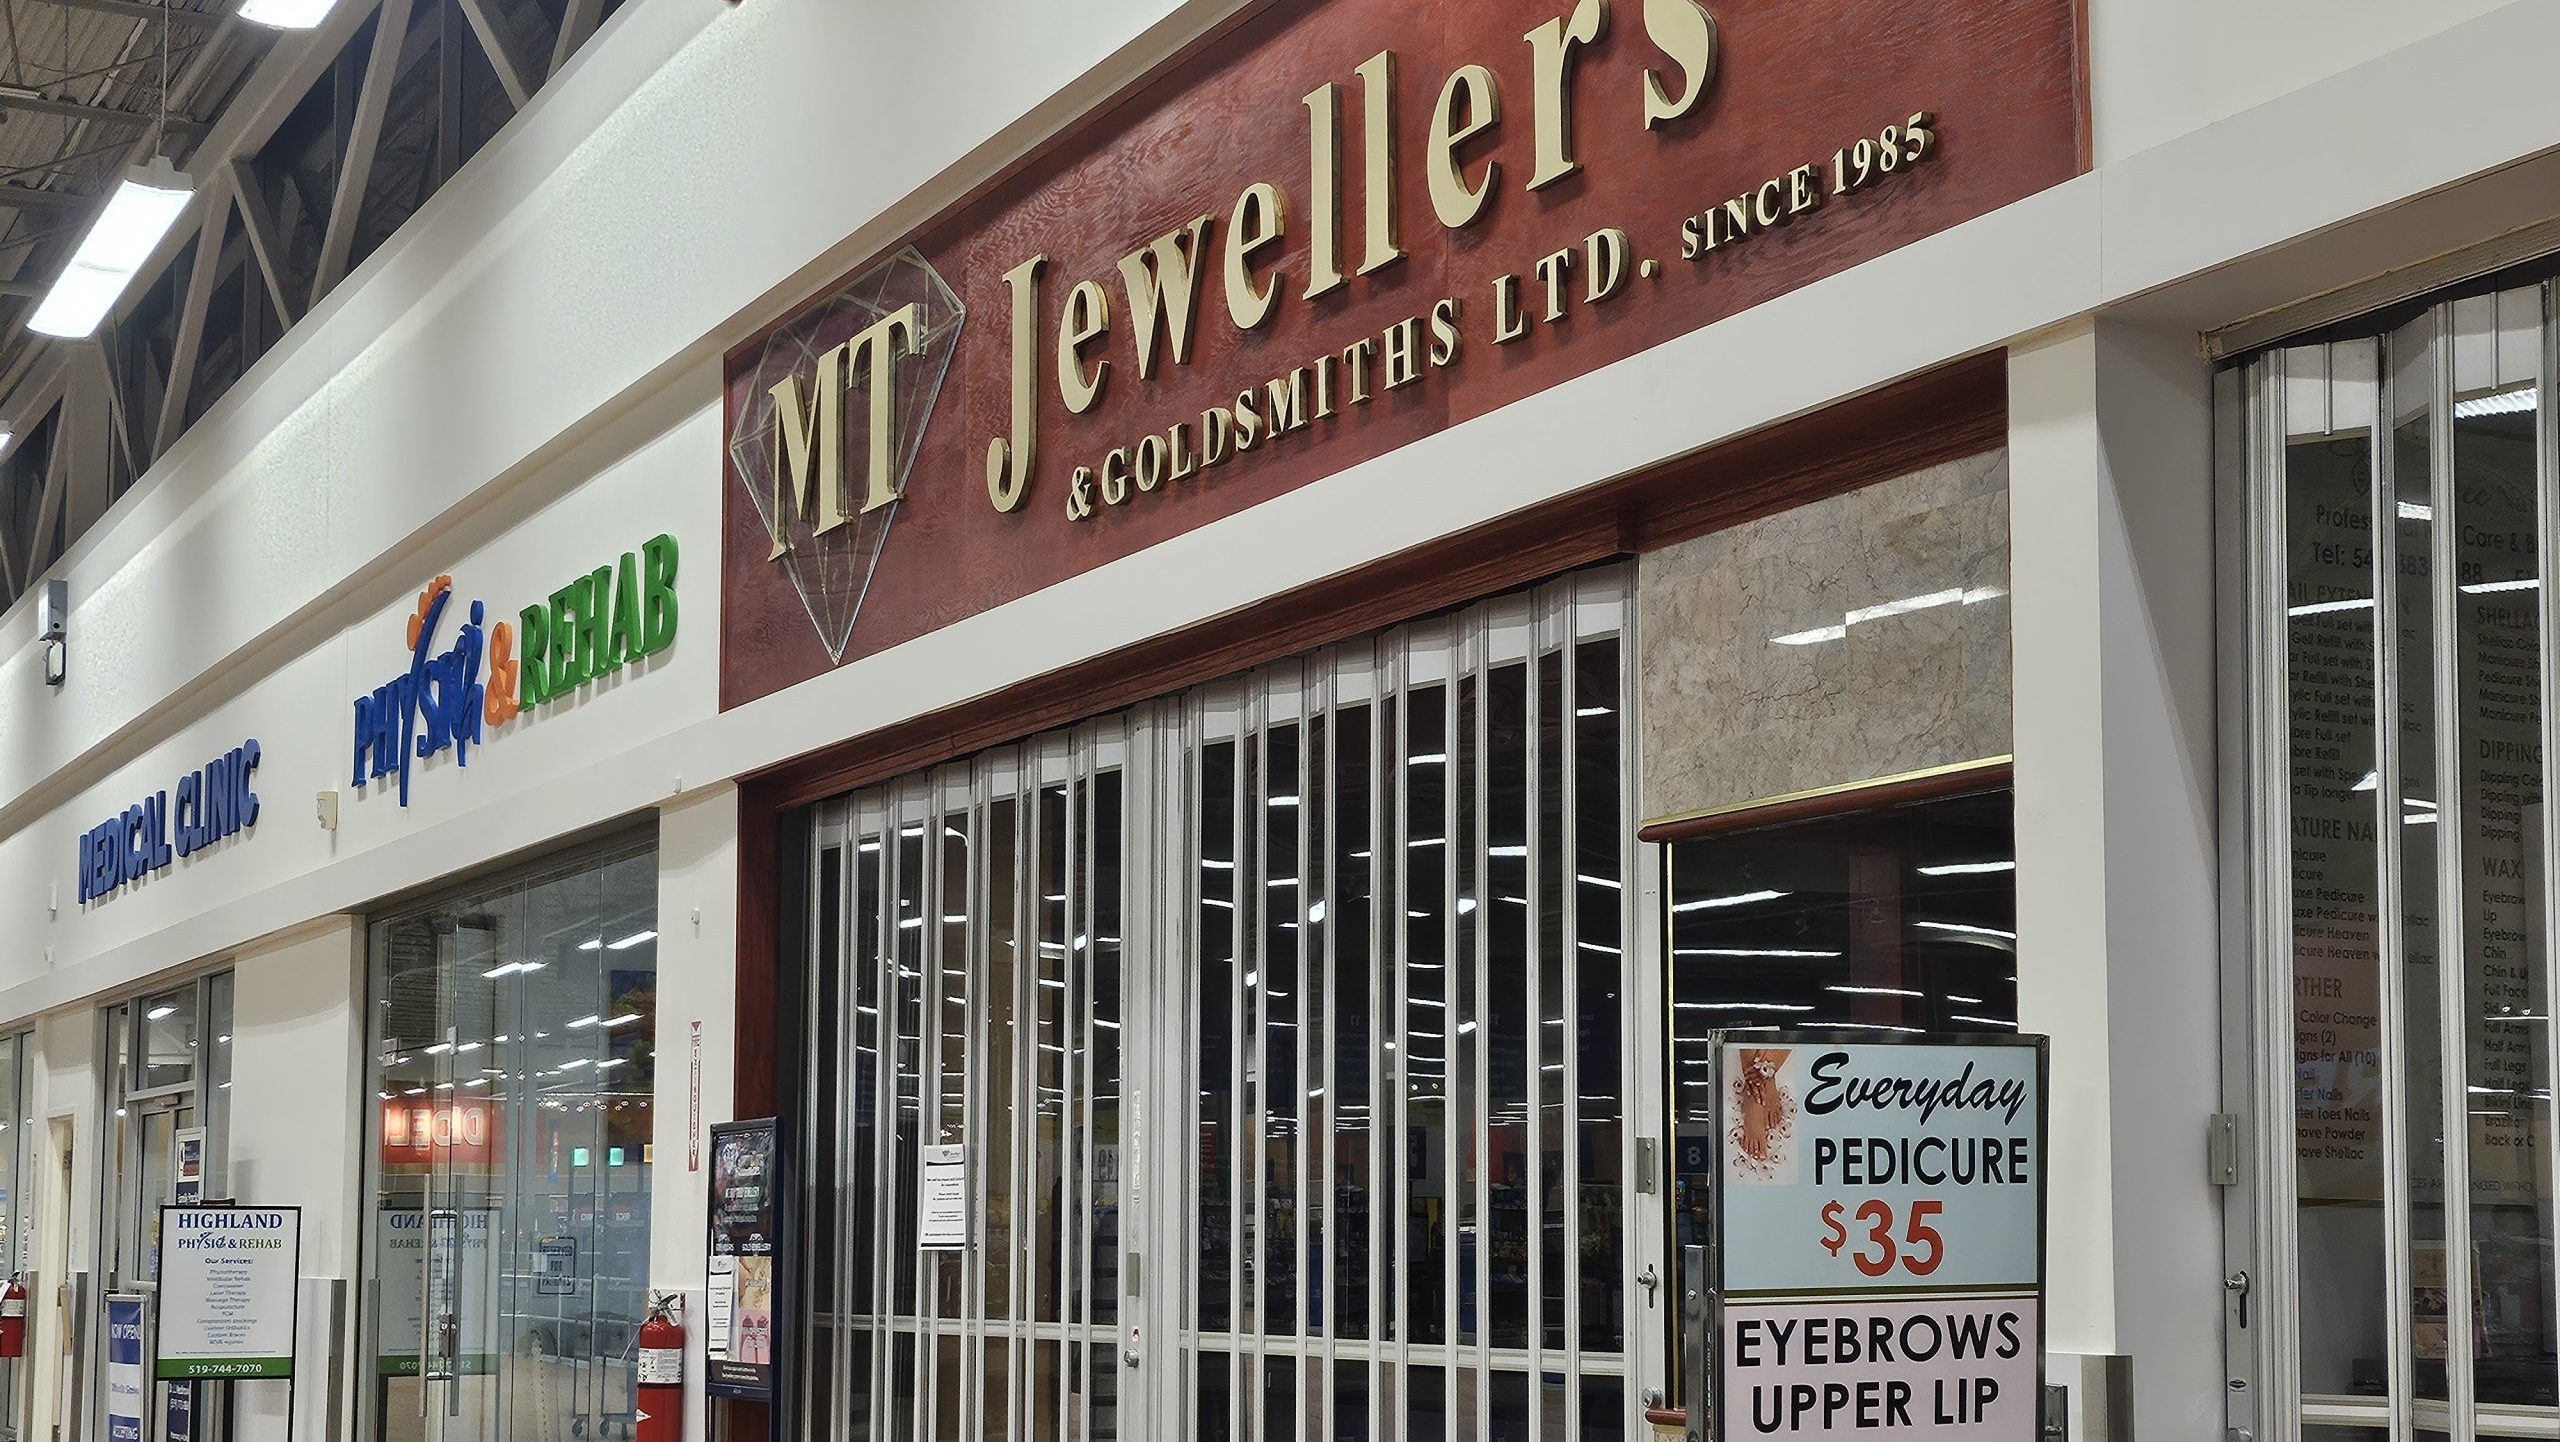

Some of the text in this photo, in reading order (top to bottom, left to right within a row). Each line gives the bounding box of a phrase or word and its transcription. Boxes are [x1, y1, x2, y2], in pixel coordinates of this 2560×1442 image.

[1492, 226, 1660, 345] LTD.
[1680, 162, 1820, 261] SINCE
[1831, 111, 1938, 196] 1985
[986, 0, 1719, 514] Jewellers
[767, 303, 928, 562] MT
[519, 534, 679, 713] REHAB
[2336, 731, 2351, 743] set
[2480, 769, 2519, 788] Dipping
[78, 738, 261, 904] MEDICAL CLINIC
[2481, 807, 2520, 825] Dipping
[2481, 825, 2520, 844] Dipping
[2316, 887, 2365, 904] Pedicure
[2316, 906, 2364, 923] Pedicure
[2484, 946, 2507, 960] Chin
[2484, 964, 2507, 978] Chin
[2300, 1010, 2377, 1029] Color Change
[2321, 1030, 2336, 1046] (2)
[2339, 1051, 2352, 1064] All
[2355, 1052, 2376, 1067] (10)
[1804, 1052, 2027, 1125] Everyday
[2325, 1126, 2366, 1141] Powder
[2485, 1134, 2511, 1147] Back
[1815, 1137, 2028, 1185] PEDICURE
[2325, 1146, 2364, 1161] Shellac
[178, 1213, 283, 1229] HIGHLAND
[228, 1239, 238, 1249] &
[239, 1238, 282, 1249] REHAB
[1820, 1199, 1944, 1277] $35
[1736, 1312, 2021, 1367] EYEBROWS
[188, 1364, 262, 1374] 519-744-7070
[1752, 1378, 2000, 1433] UPPER LIP
